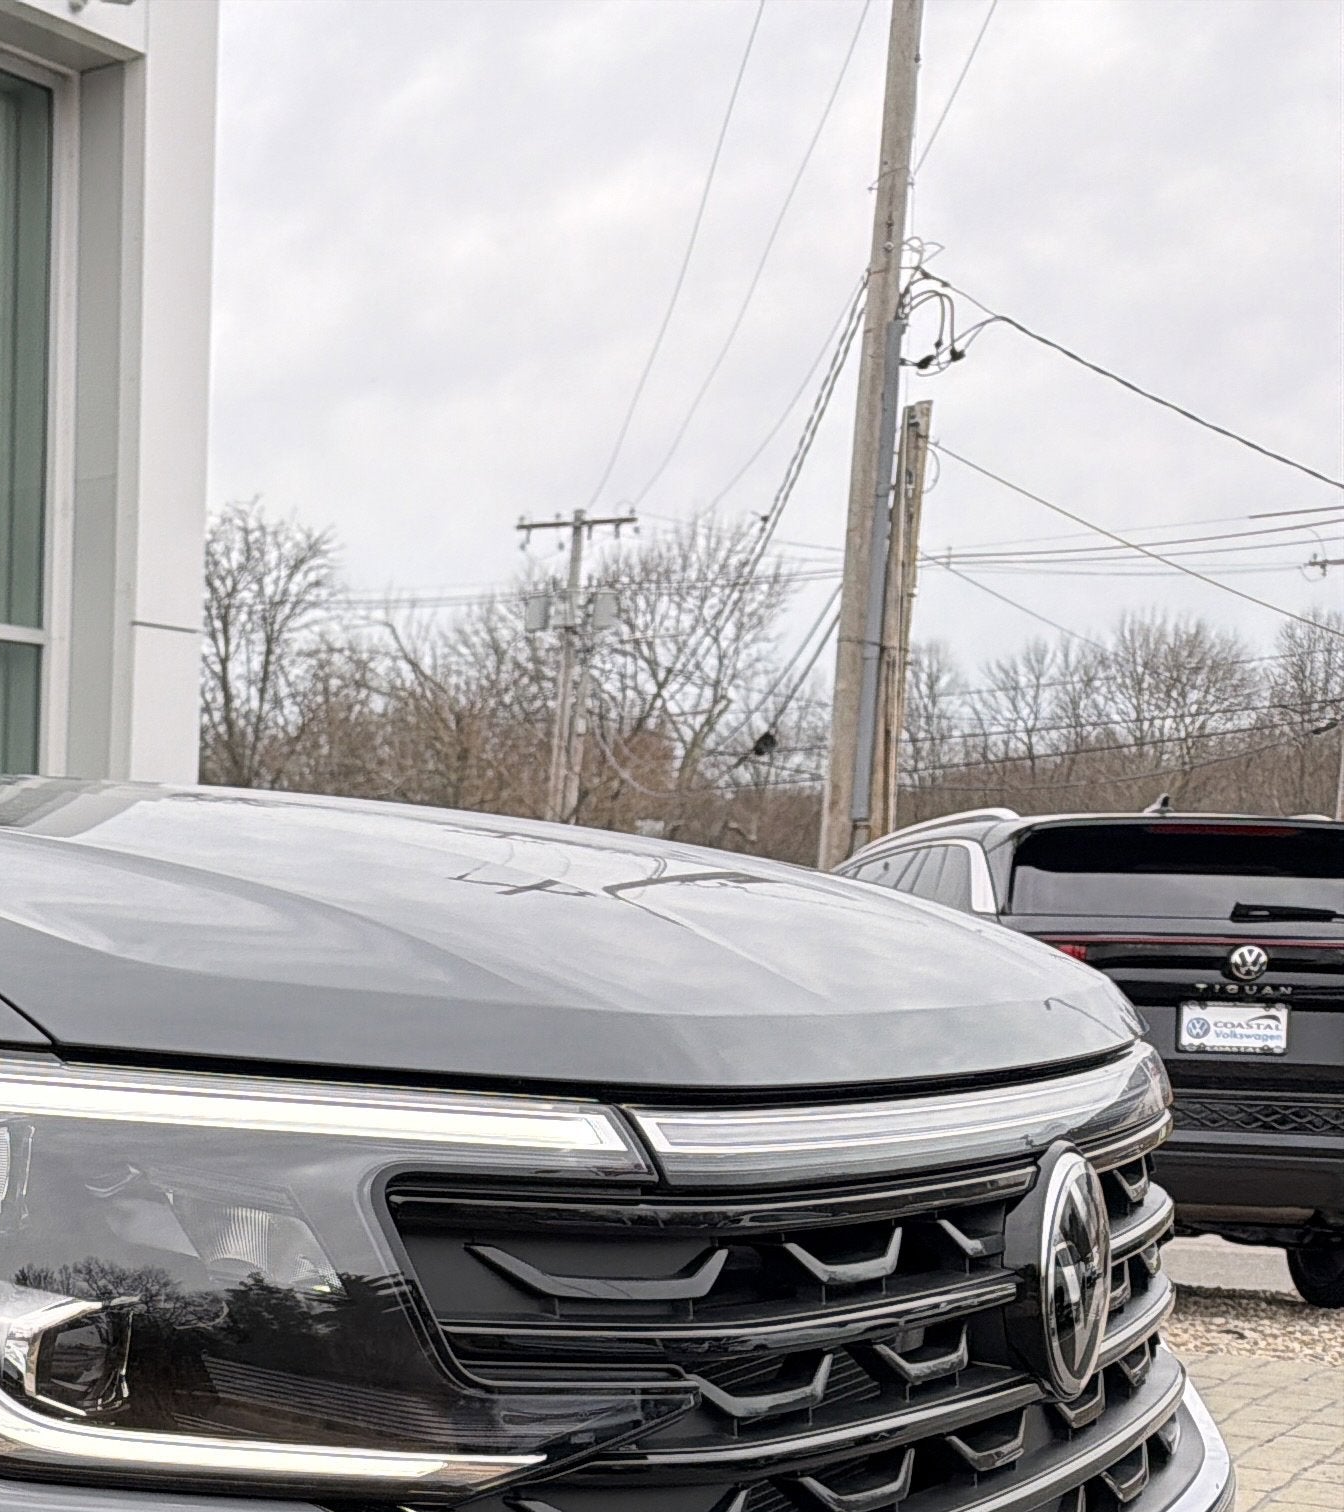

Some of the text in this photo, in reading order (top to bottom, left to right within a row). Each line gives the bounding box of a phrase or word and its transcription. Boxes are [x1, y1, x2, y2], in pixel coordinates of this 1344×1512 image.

[1195, 983, 1293, 995] TIGUAN
[1213, 1021, 1281, 1032] COASTAL
[1215, 1030, 1282, 1042] Volkswagen
